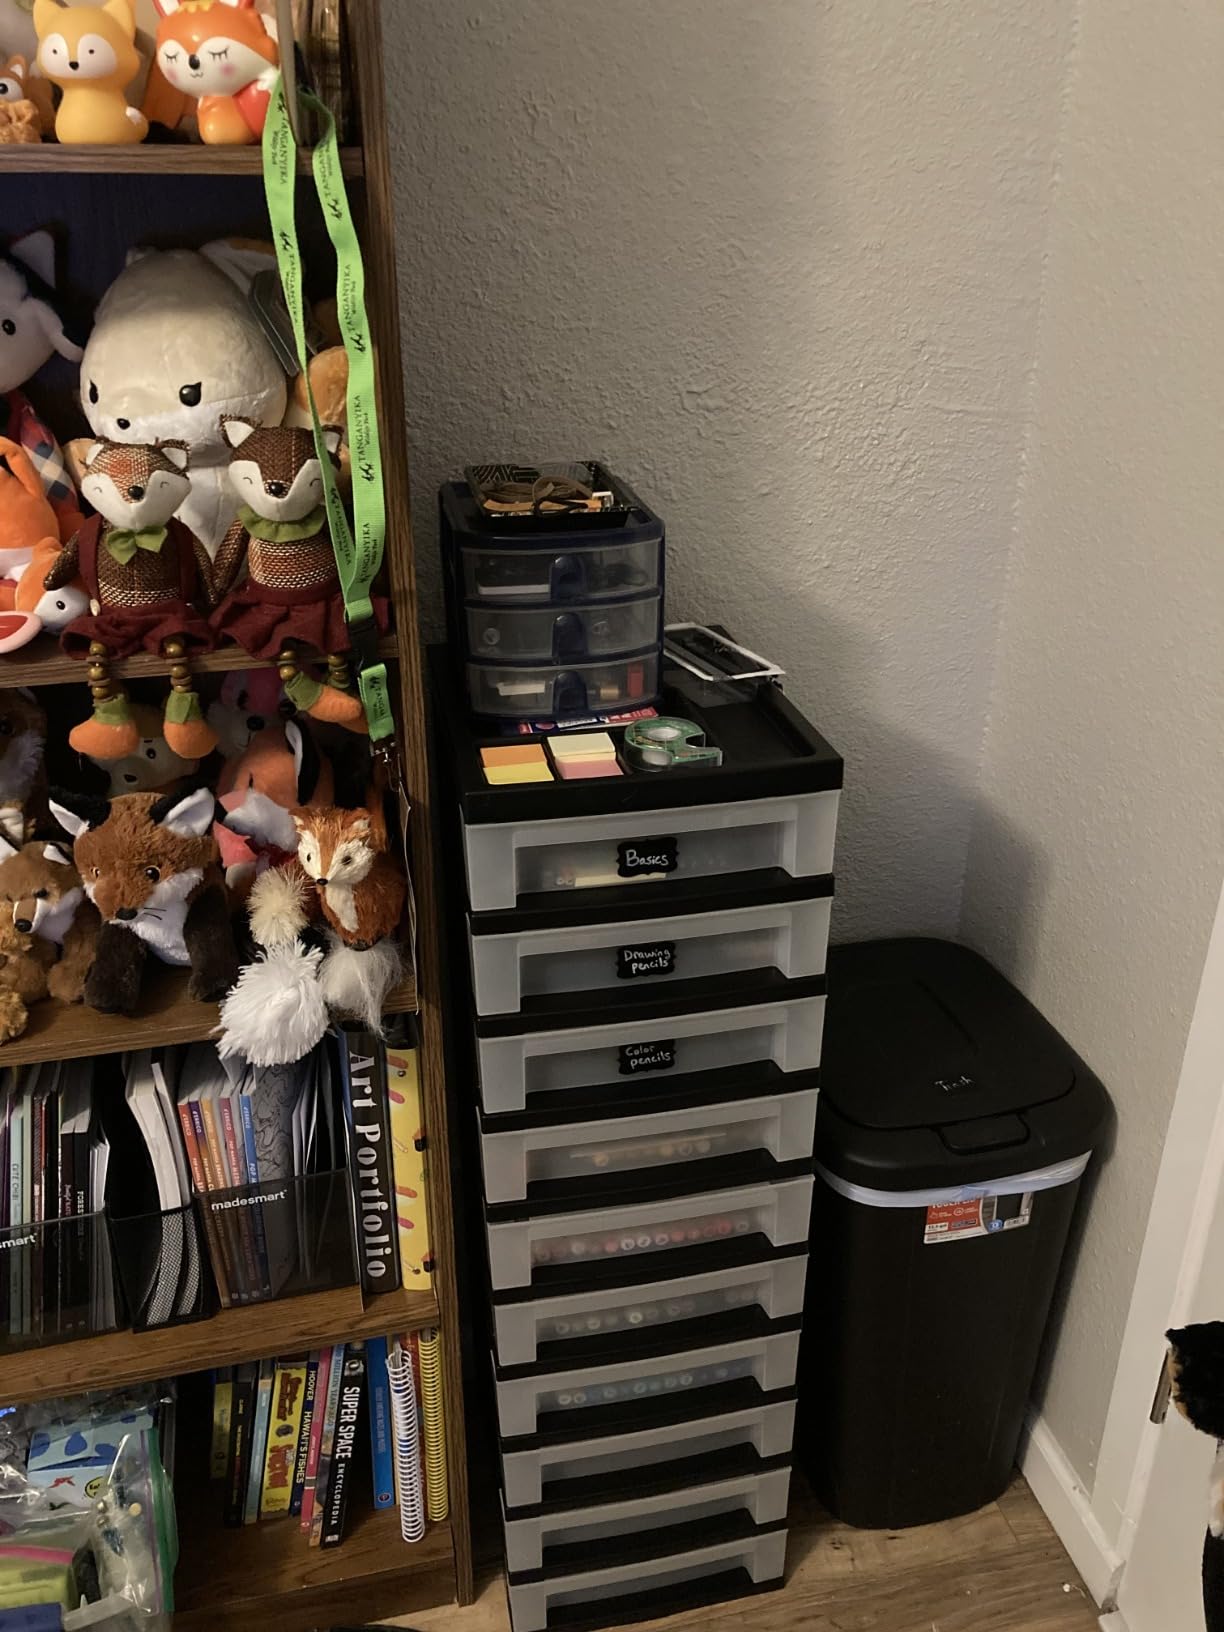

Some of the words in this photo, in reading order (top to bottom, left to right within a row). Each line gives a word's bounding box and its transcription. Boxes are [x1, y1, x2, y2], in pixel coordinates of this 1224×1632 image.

[354, 395, 366, 461] TANGANYIKA
[625, 849, 669, 867] Basics
[623, 949, 671, 962] Drawing
[631, 956, 669, 974] pencils
[625, 1045, 655, 1056] Color
[630, 1050, 671, 1070] pencils
[350, 1053, 377, 1108] Art
[211, 1191, 286, 1211] madesmart
[355, 1123, 392, 1278] Portfolio
[306, 1370, 317, 1401] HOOVER
[340, 1386, 360, 1423] SUPER
[336, 1425, 356, 1460] SPACE
[296, 1453, 307, 1484] FISHES
[330, 1463, 346, 1526] ENCYCLOPEDIA
